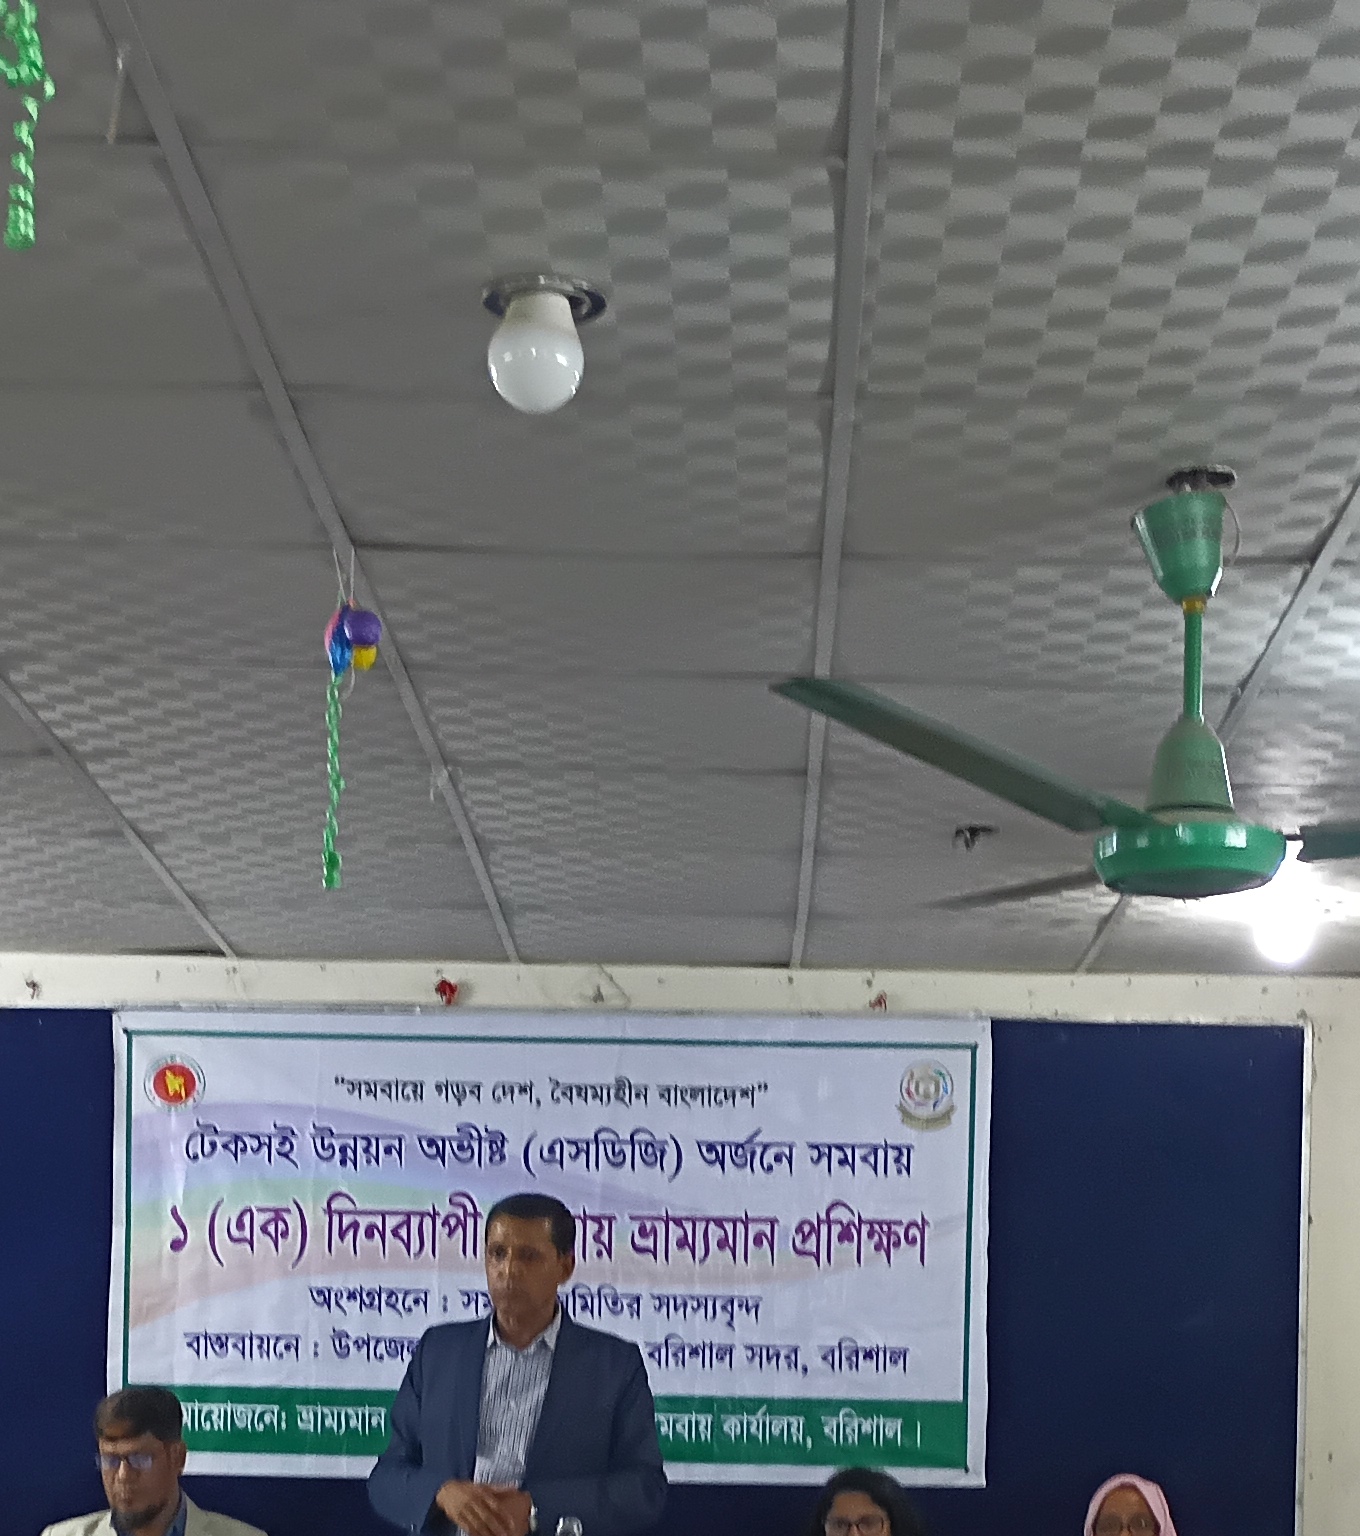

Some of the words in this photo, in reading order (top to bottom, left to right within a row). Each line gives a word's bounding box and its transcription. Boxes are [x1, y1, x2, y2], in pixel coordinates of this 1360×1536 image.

[492, 1080, 541, 1108] দেশ,
[185, 1119, 299, 1168] টেকসই
[311, 1119, 405, 1170] উন্নয়ন
[418, 1122, 508, 1167] অভীষ্ট
[523, 1128, 682, 1181] (এসডিজি)
[697, 1128, 797, 1176] অর্জনে
[808, 1139, 915, 1178] সমবায়
[169, 1205, 188, 1252] ১
[209, 1198, 308, 1269] (এক)
[324, 1191, 483, 1258] দিনব্যাপী
[630, 1207, 778, 1267] ভ্রাম্যমান
[792, 1200, 929, 1267] প্রশিক্ষণ
[650, 1293, 763, 1331] সদস্যবৃন্দ
[184, 1329, 301, 1361] বাস্তবায়নে
[645, 1334, 735, 1371] বরিশাল
[744, 1345, 808, 1377] সদর,
[818, 1337, 910, 1374] বরিশাল
[296, 1402, 387, 1436] ভ্রাম্যমান
[654, 1411, 713, 1443] মবায়
[721, 1405, 812, 1453] কার্যালয়,
[822, 1408, 902, 1447] বরিশাল
